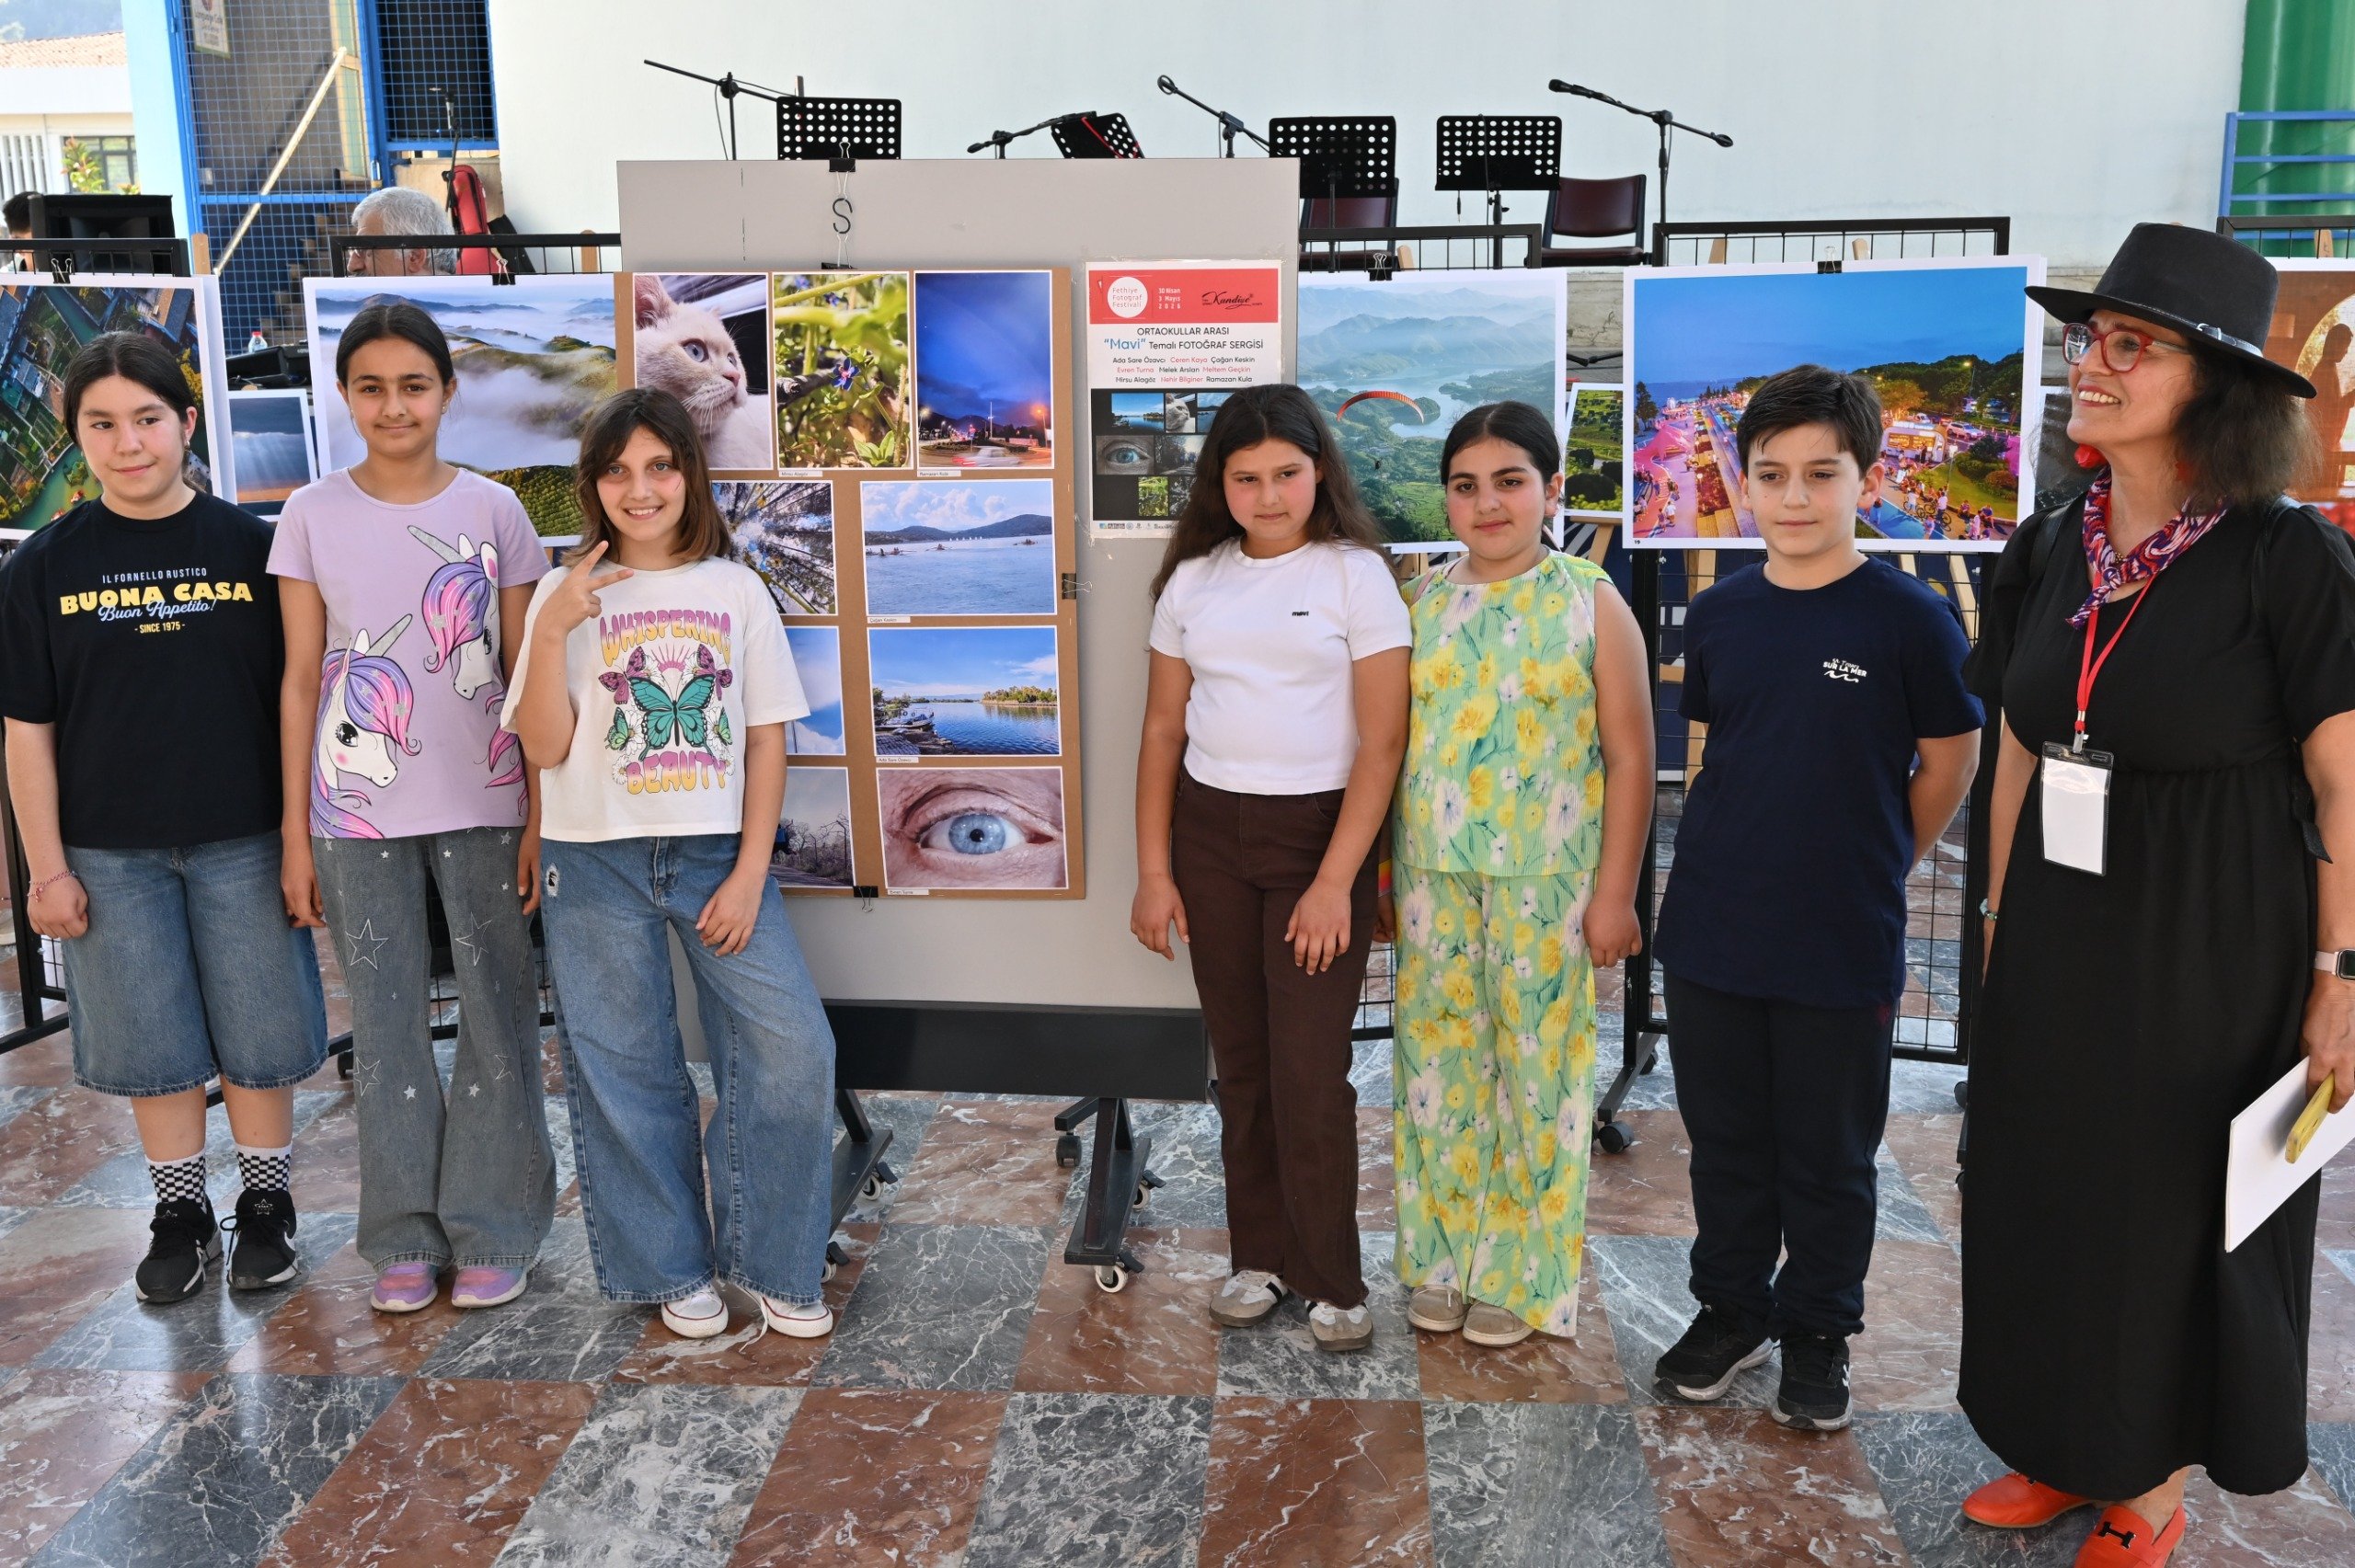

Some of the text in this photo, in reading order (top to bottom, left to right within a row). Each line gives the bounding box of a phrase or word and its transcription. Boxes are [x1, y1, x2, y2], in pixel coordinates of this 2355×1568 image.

[1137, 326, 1230, 336] ORTAOKULLAR ARASI
[1149, 341, 1177, 349] Temalı
[1178, 338, 1227, 349] FOTOĞRAF
[1229, 338, 1264, 349] SERGİSİ
[1211, 356, 1234, 364] Çağan
[1179, 375, 1203, 383] Bilginer
[102, 567, 207, 584] IL FORNELLO RUSTICO
[60, 581, 253, 615] BUONA CASA
[98, 599, 217, 622] Buon Appetito!
[139, 621, 181, 634] SINCE 1975
[600, 609, 731, 667] WHISPERING
[1822, 661, 1867, 678] SUR LA MER
[626, 750, 726, 795] BEAUTY
